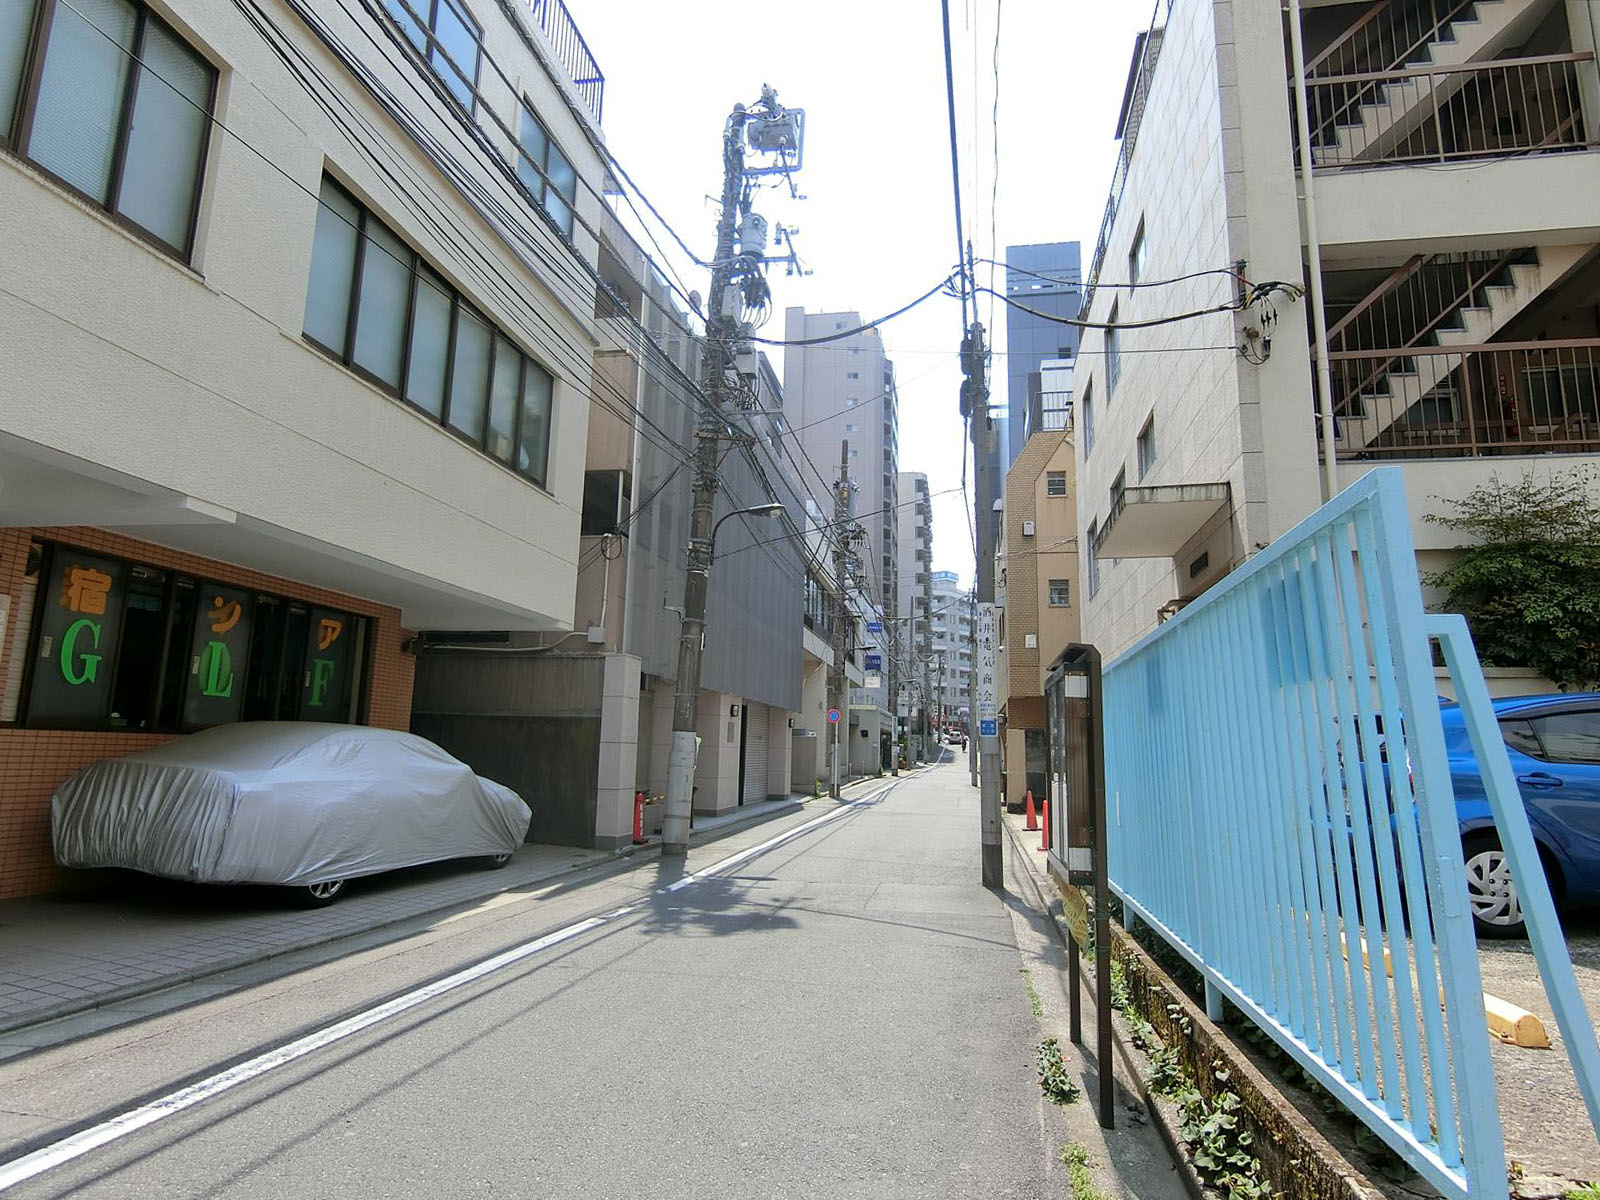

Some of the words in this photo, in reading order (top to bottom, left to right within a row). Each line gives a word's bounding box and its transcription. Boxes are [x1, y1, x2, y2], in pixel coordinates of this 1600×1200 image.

[66, 568, 112, 614] 宿
[61, 620, 102, 684] G
[310, 660, 333, 705] F
